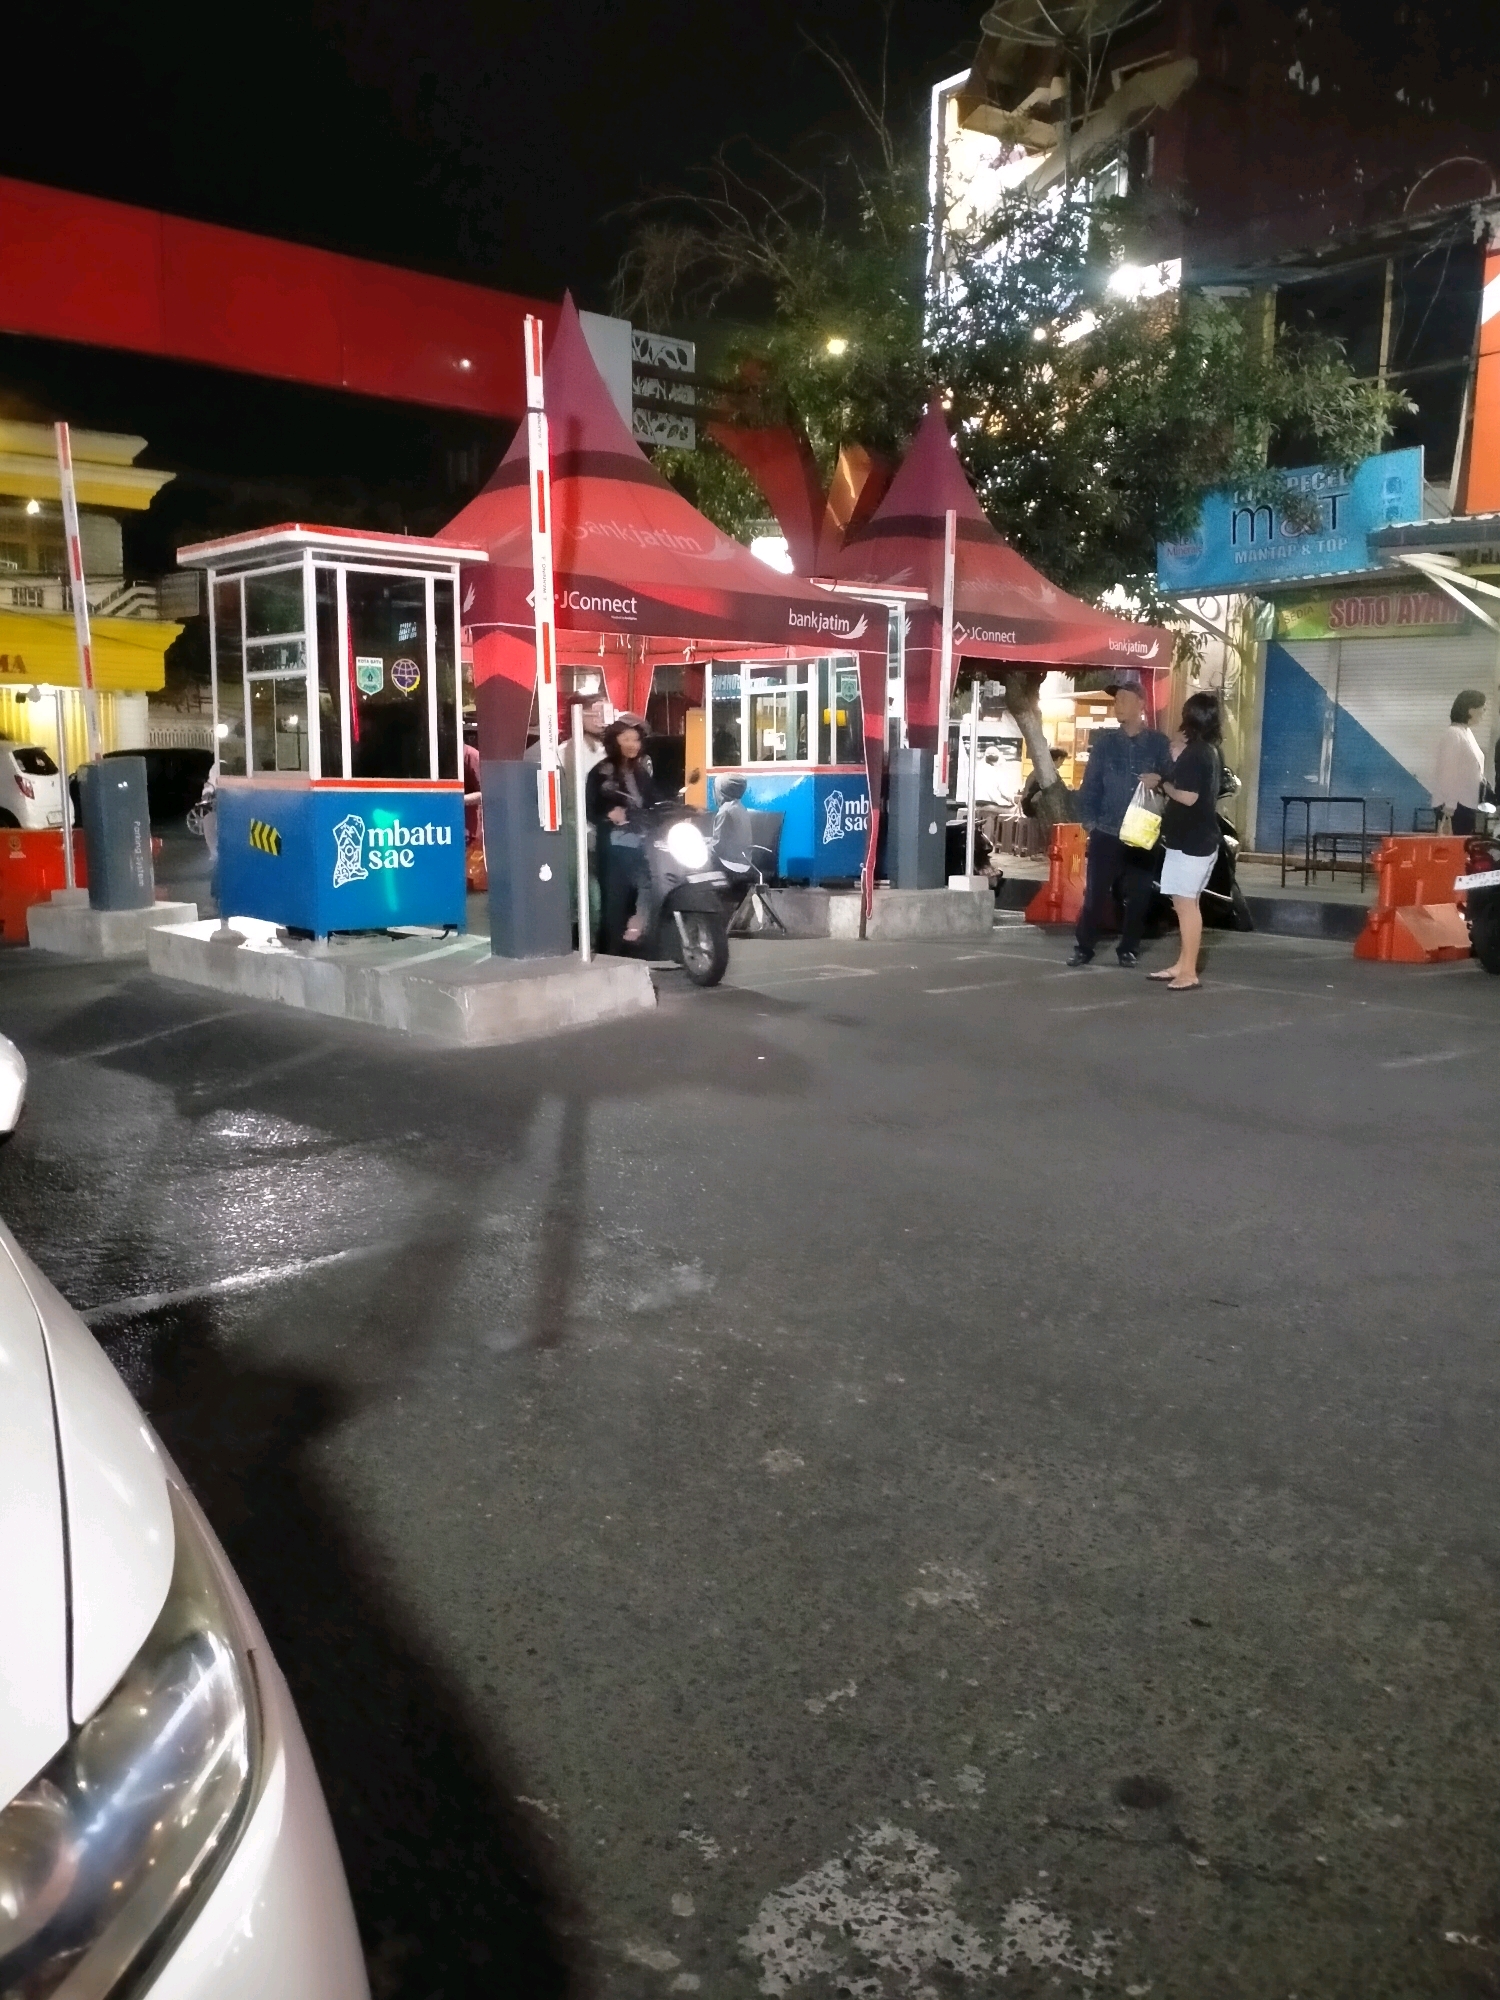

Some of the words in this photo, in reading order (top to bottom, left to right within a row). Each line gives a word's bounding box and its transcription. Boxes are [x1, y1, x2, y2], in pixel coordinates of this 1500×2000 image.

[1234, 544, 1297, 564] MANTAP
[1301, 543, 1311, 556] &
[1317, 537, 1348, 554] TOP
[560, 590, 638, 615] JConnect
[1284, 605, 1315, 625] SEDIA
[1328, 595, 1392, 631] SOTO
[1394, 592, 1466, 627] AYAM
[788, 607, 850, 634] bankjatim
[970, 626, 1016, 644] JConnect
[1108, 637, 1148, 656] bankjatim
[133, 820, 142, 854] Parking
[367, 818, 452, 848] mbatu
[136, 856, 144, 887] System
[368, 848, 415, 870] sae
